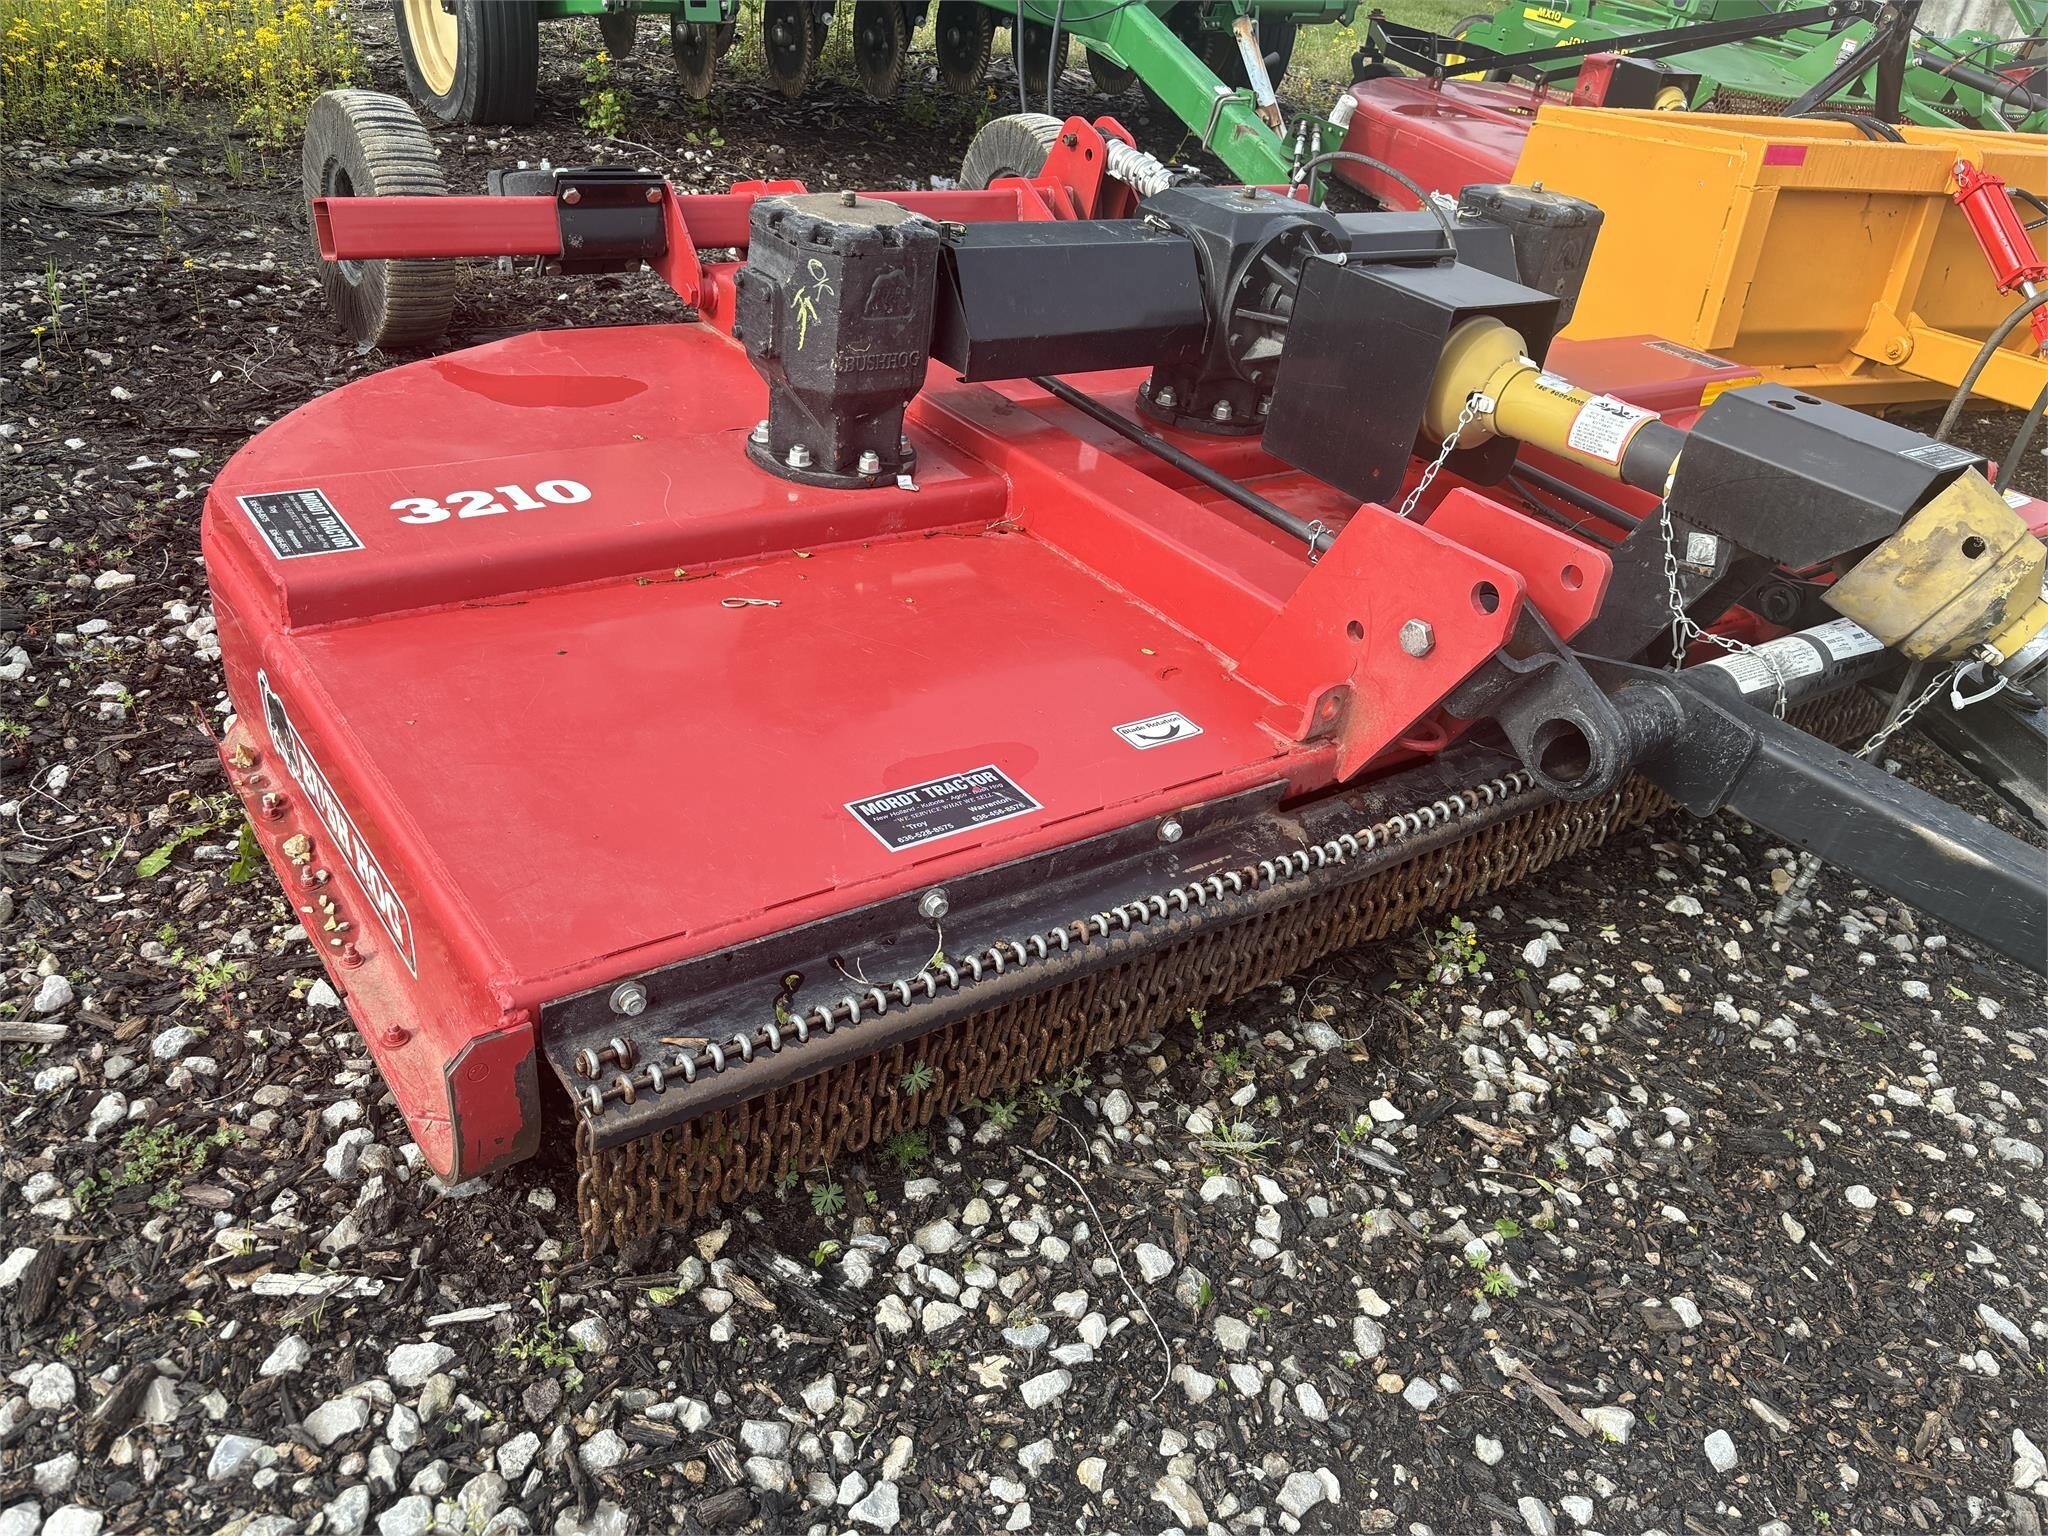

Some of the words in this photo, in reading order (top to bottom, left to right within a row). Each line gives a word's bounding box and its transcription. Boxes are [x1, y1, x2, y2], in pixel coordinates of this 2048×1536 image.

[1537, 7, 1562, 22] MX10
[389, 479, 592, 524] 3210
[298, 493, 330, 515] MORDT
[316, 516, 353, 547] TRACTOR
[1122, 726, 1145, 734] Blade
[1146, 717, 1181, 728] Rotation
[858, 791, 922, 816] MORDT
[921, 771, 999, 797] TRACTOR
[873, 813, 889, 822] New
[890, 807, 915, 817] Holland
[920, 798, 945, 809] Kubota
[950, 792, 967, 802] Agco
[912, 807, 942, 819] SERVICE
[942, 802, 963, 812] WHAT
[963, 797, 975, 805] WE
[907, 820, 928, 830] Troy
[968, 797, 1012, 813] Warrenton
[300, 747, 353, 860] BUSH
[352, 834, 404, 946] HOG
